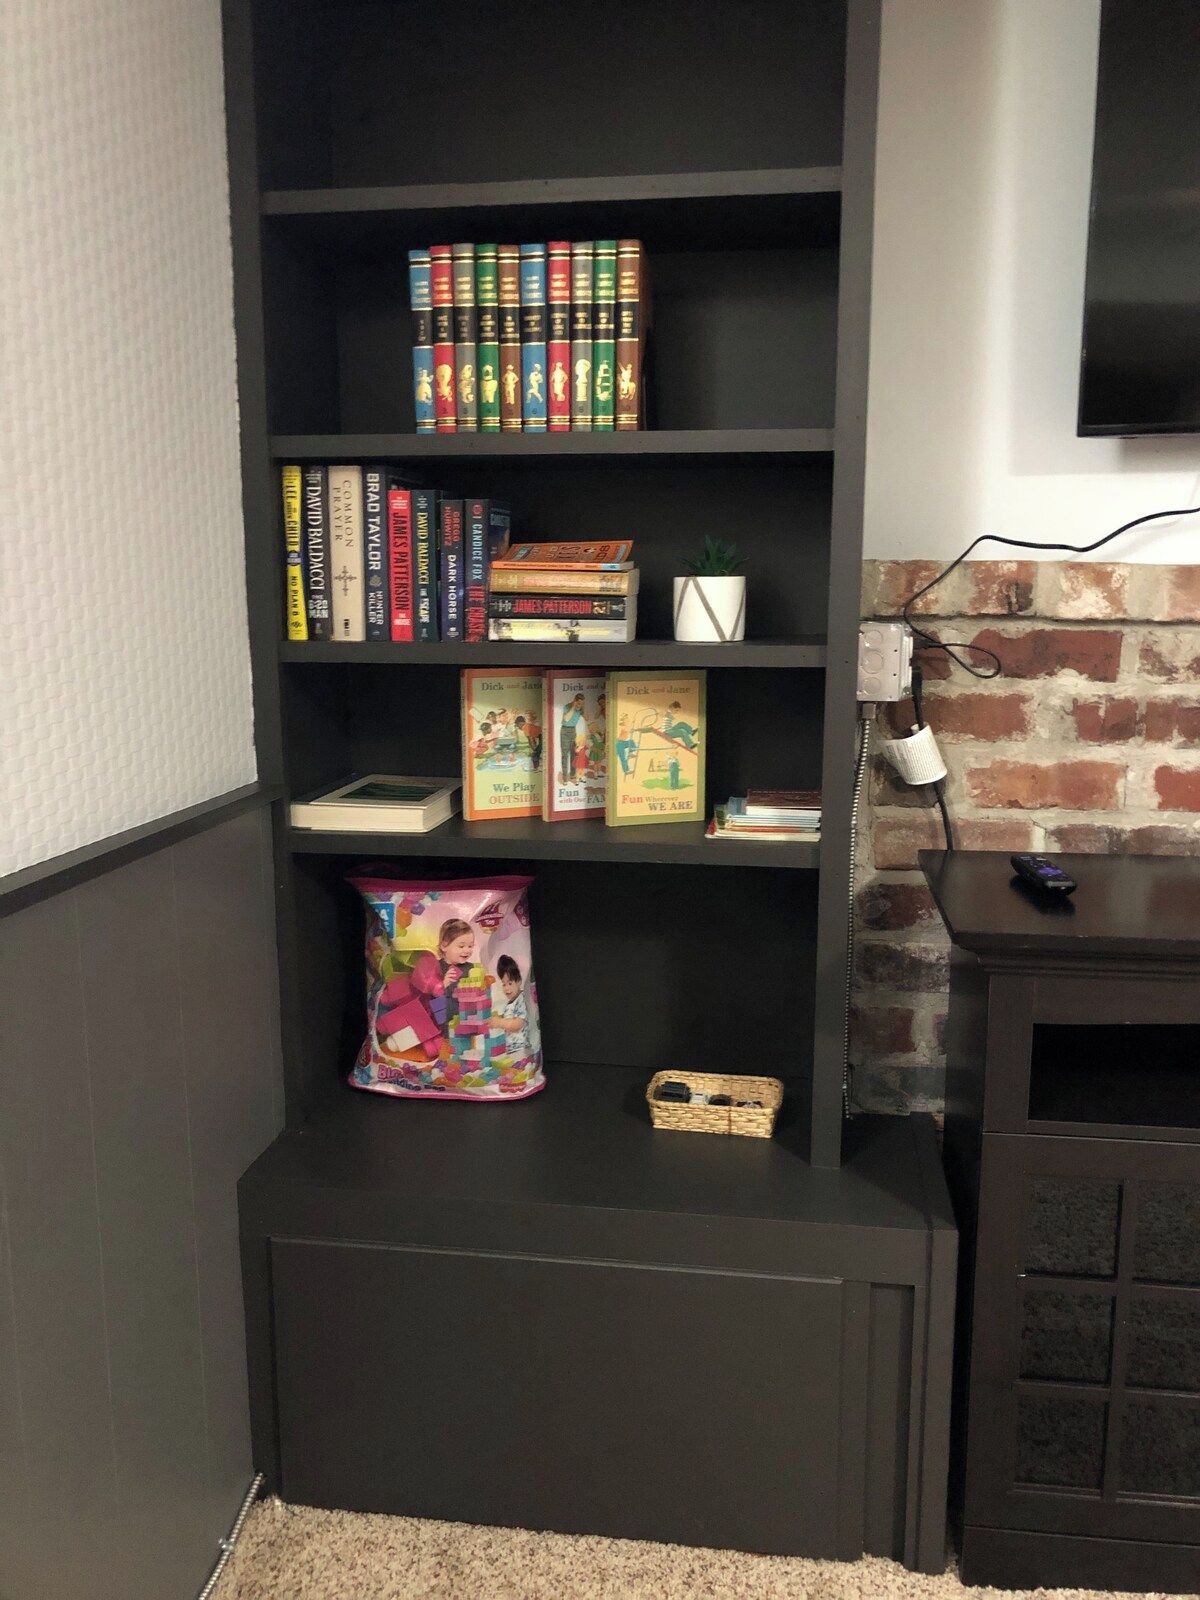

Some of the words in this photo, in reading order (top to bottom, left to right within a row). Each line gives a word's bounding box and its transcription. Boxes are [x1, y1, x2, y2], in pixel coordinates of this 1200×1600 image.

[306, 487, 322, 525] DAVID
[366, 473, 380, 512] BRAD
[333, 487, 342, 541] PRAYER
[343, 480, 353, 547] COMMON
[416, 512, 428, 539] DAVID
[444, 506, 452, 546] HURWITZ
[287, 521, 299, 546] CHILD
[367, 516, 381, 570] TAYLOR
[392, 512, 408, 547] JAMES
[472, 524, 482, 560] CANDICE
[307, 529, 325, 589] BALDACCI
[417, 542, 429, 584] BALDACCI
[448, 555, 457, 582] DARK
[472, 564, 482, 580] FOX
[291, 576, 298, 586] NO
[393, 552, 410, 610] PATTERSON
[467, 585, 485, 601] THE
[368, 592, 376, 623] KILLER
[448, 586, 457, 620] HORSE
[514, 599, 542, 614] JAMES
[543, 600, 592, 614] PATTERSON
[481, 683, 504, 691] Dick
[562, 682, 584, 692] Dick
[626, 686, 650, 695] Dick
[667, 685, 691, 694] Jane
[489, 793, 540, 804] OUTSIDE
[493, 783, 509, 793] We
[513, 782, 536, 793] Play
[558, 788, 579, 798] Fun
[622, 794, 643, 804] Fun
[648, 803, 667, 811] WE
[670, 801, 693, 811] ARE
